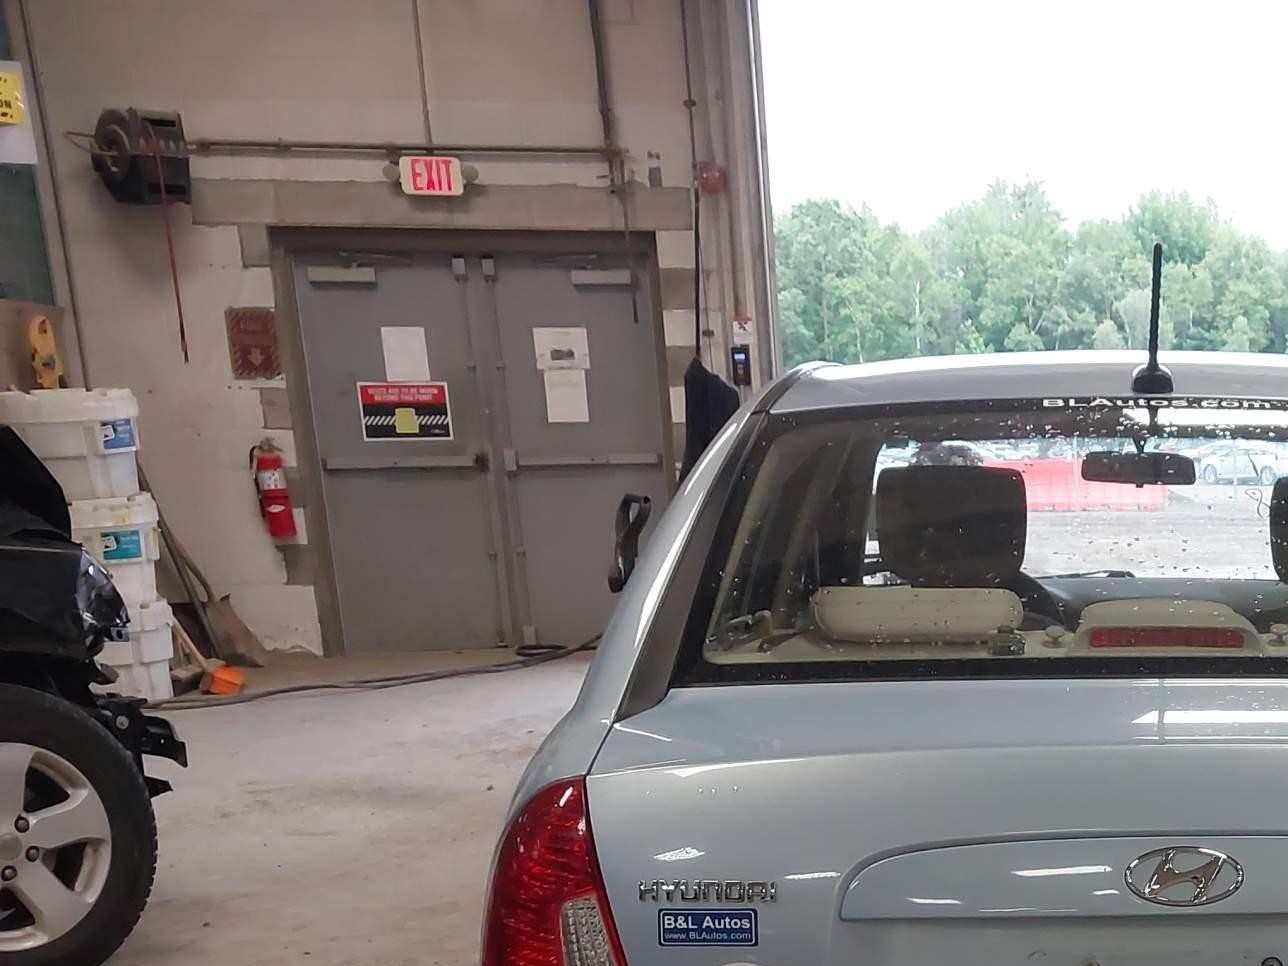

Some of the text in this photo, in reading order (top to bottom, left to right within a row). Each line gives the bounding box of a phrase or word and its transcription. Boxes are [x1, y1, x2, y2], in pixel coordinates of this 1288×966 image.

[411, 159, 452, 191] EXIT
[1042, 398, 1271, 409] BLAutos.com
[638, 879, 777, 903] HYUNDAI
[664, 915, 751, 929] B&L Autos
[664, 931, 751, 941] www.BLAutos.com
